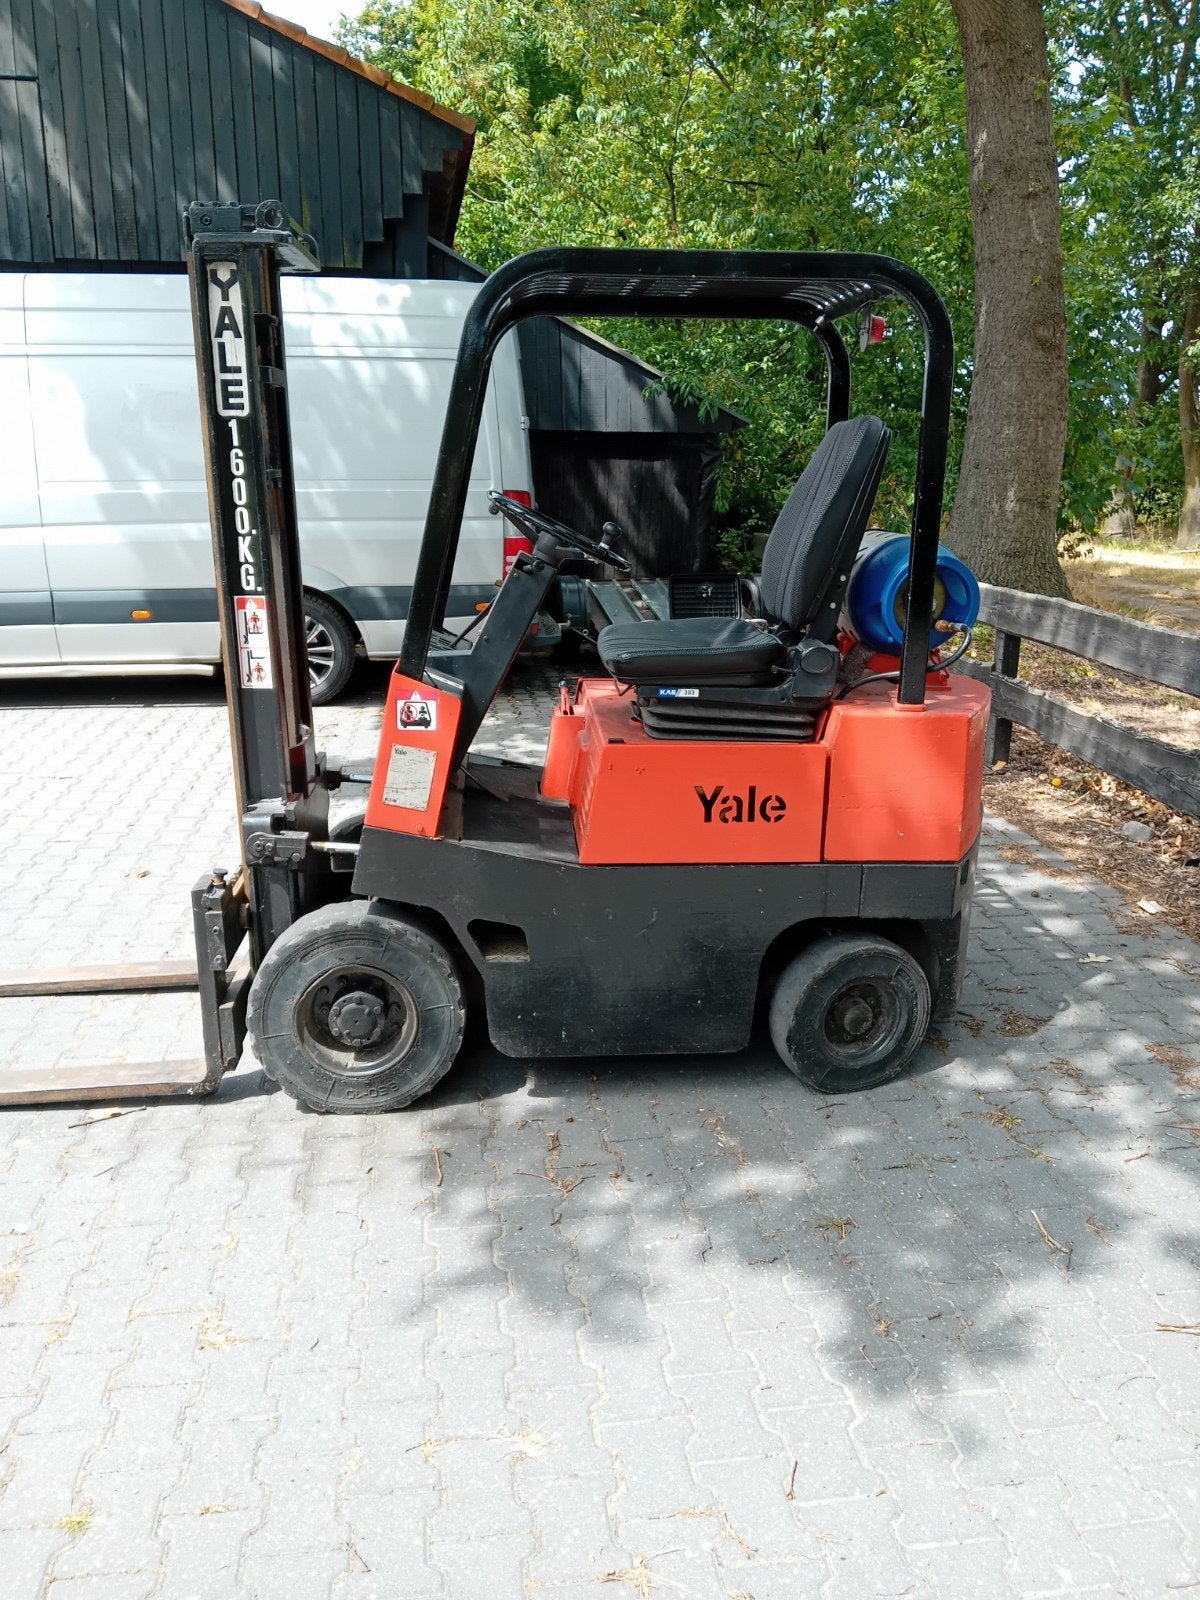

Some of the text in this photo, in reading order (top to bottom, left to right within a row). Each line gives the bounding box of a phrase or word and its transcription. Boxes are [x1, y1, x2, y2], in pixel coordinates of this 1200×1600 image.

[209, 268, 245, 411] YALE
[394, 747, 408, 757] Yale
[693, 785, 787, 824] Yale
